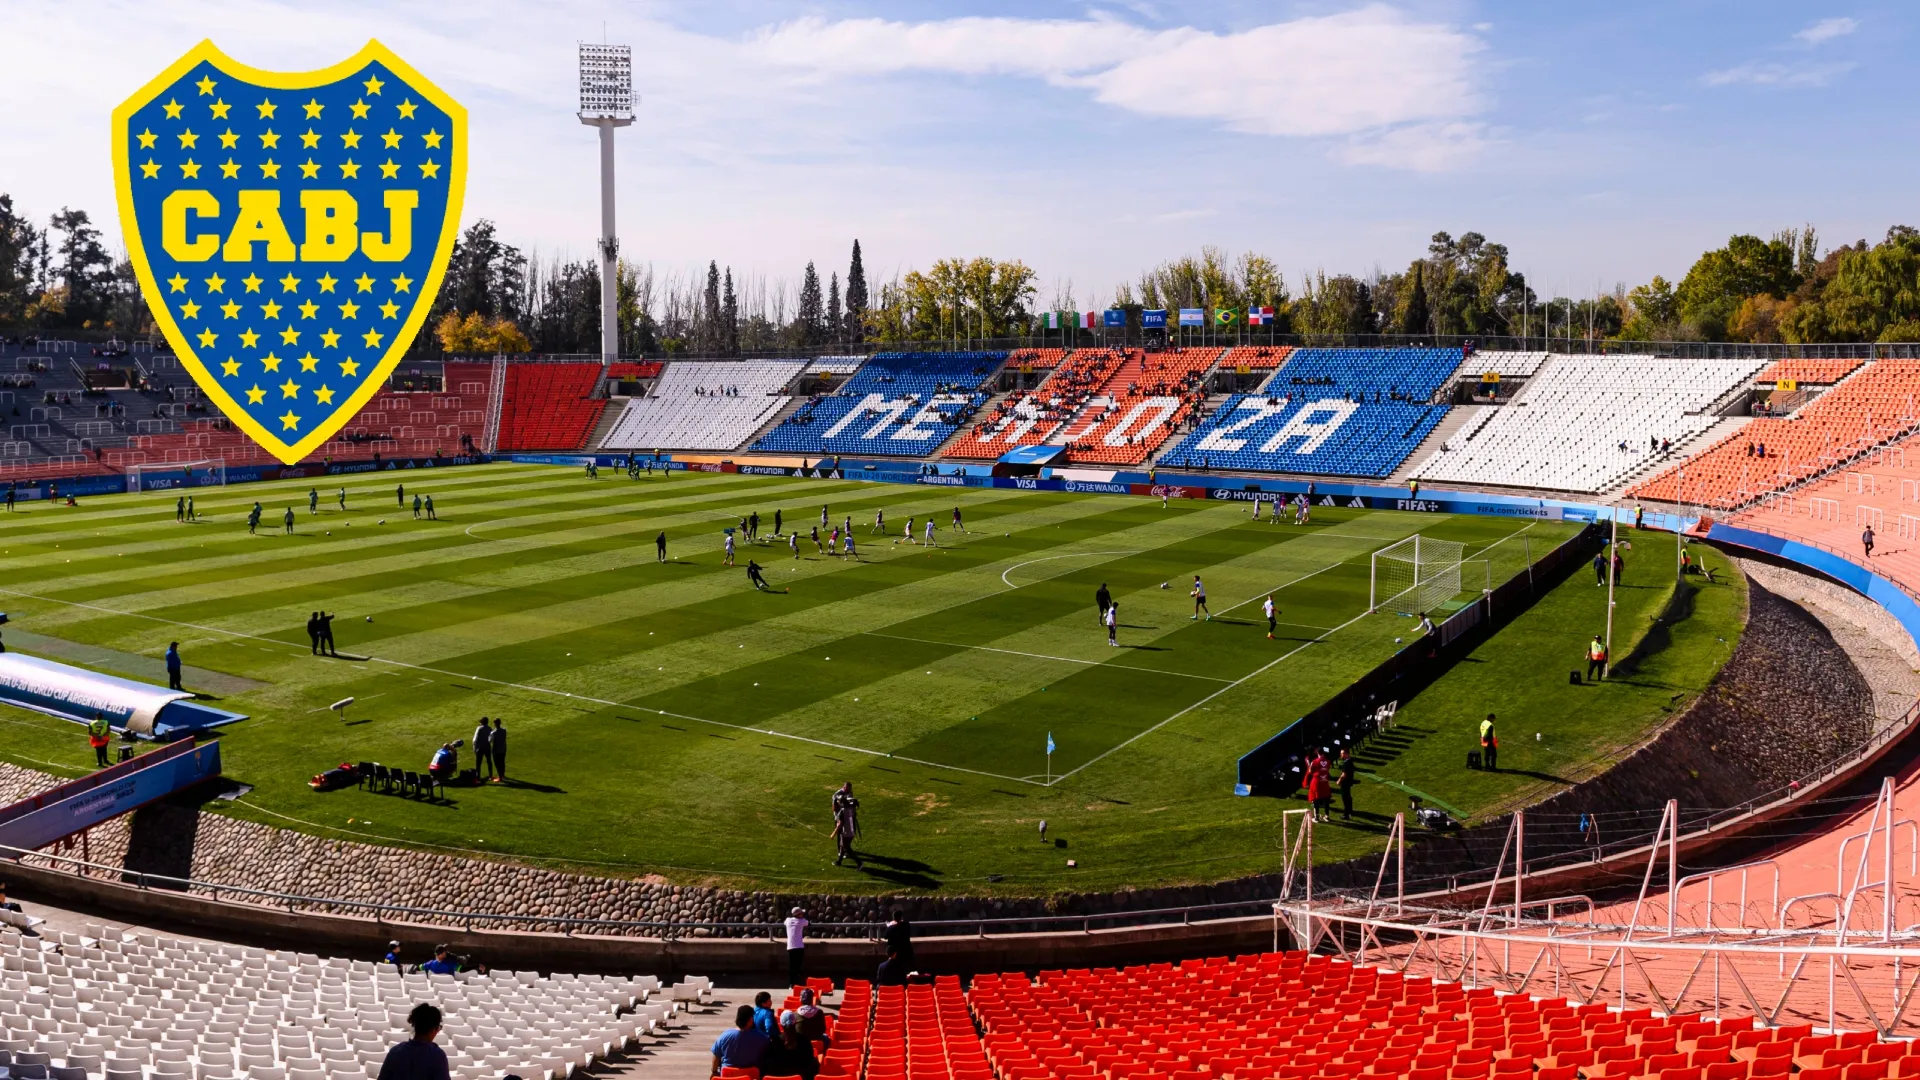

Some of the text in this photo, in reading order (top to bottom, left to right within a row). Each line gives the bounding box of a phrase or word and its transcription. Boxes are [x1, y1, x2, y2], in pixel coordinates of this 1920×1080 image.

[1145, 315, 1162, 323] FIFA
[1783, 380, 1790, 389] N
[344, 464, 377, 473] HYUNDAI
[754, 467, 785, 475] HYUNDAI
[848, 471, 863, 479] FIFA
[881, 473, 910, 481] WORLD
[923, 475, 964, 485] ARGENTINA
[149, 479, 172, 489] VISA
[1016, 479, 1037, 489] VISA
[1477, 505, 1548, 517] FIFA.com/tickets
[27, 681, 52, 697] WORLD
[53, 687, 69, 701] CUP
[67, 691, 108, 711] ARGENTINA
[73, 795, 116, 816] ARGENTINA
